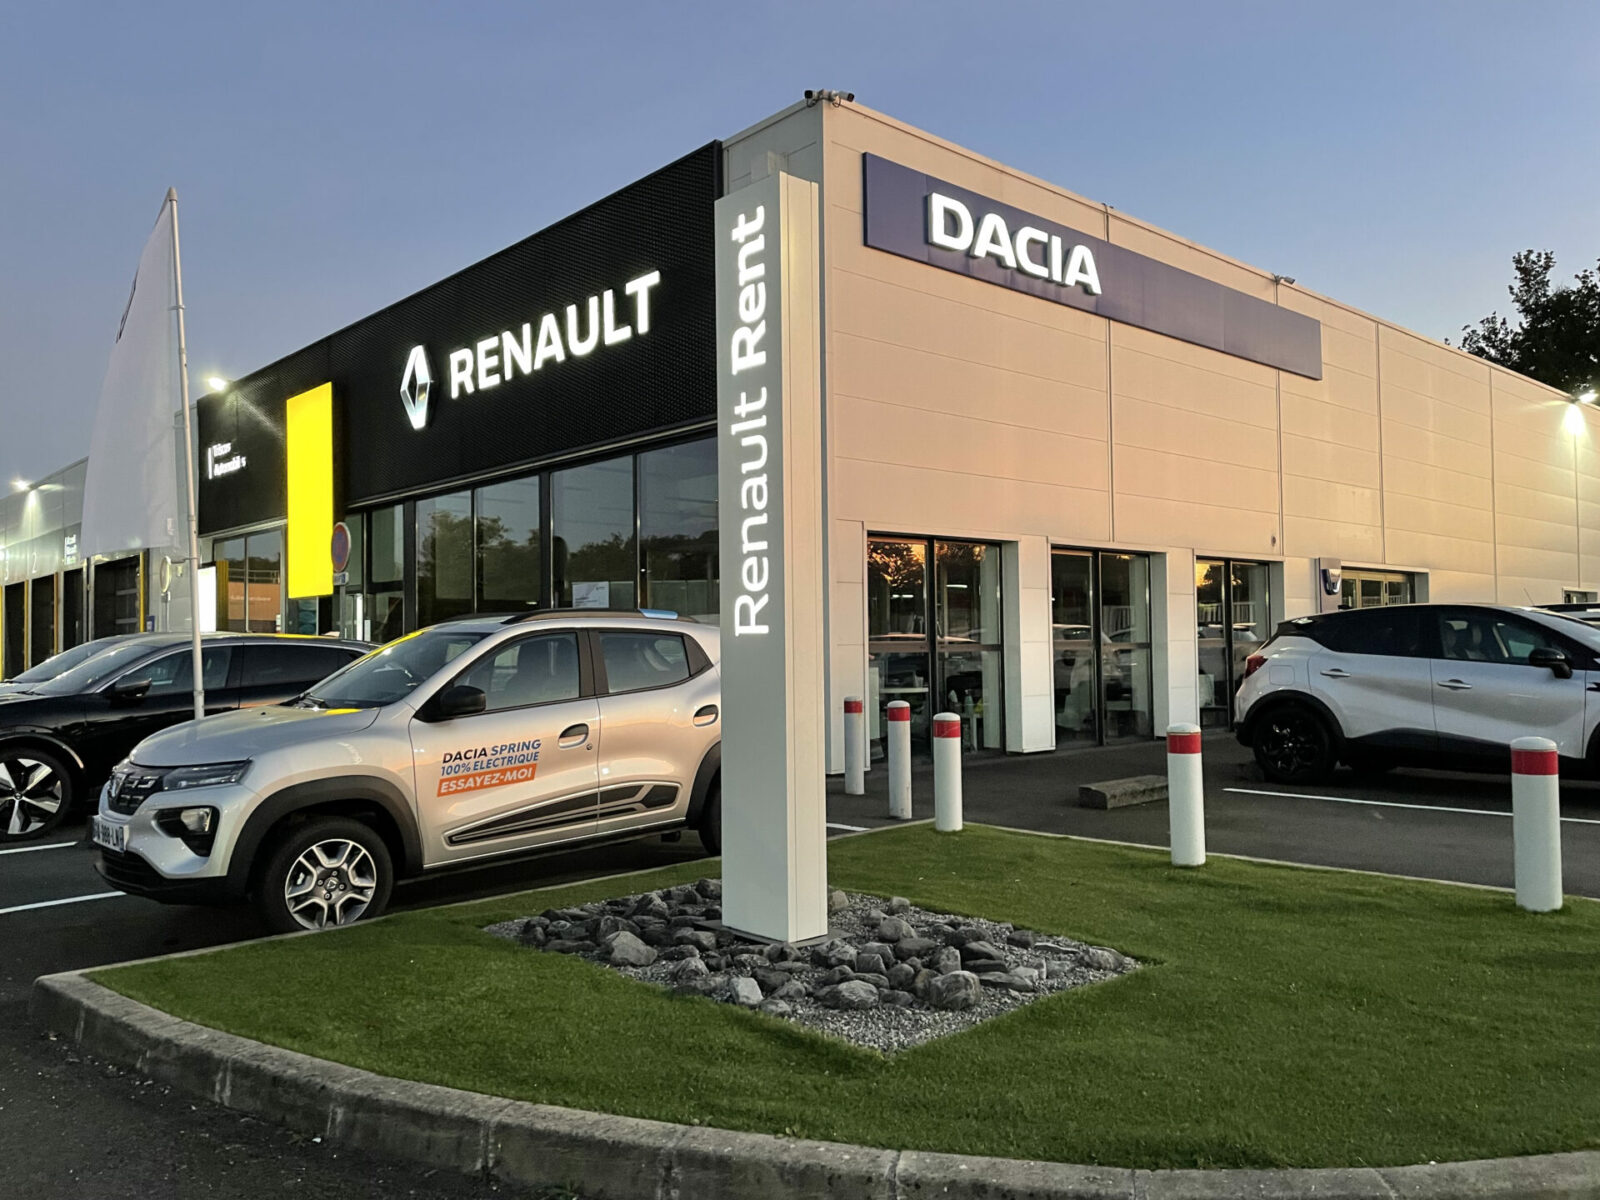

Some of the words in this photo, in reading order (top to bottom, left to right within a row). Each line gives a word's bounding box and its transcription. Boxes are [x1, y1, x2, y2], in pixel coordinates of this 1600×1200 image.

[731, 205, 767, 376] Rent
[929, 192, 1102, 295] DACIA
[449, 270, 661, 399] RENAULT
[731, 386, 769, 637] Renault
[440, 767, 533, 793] ESSAYEZ-MOI
[441, 761, 471, 776] 100%
[473, 751, 540, 771] ELECTRIQUE
[442, 747, 488, 764] DACIA
[490, 739, 542, 756] SPRING
